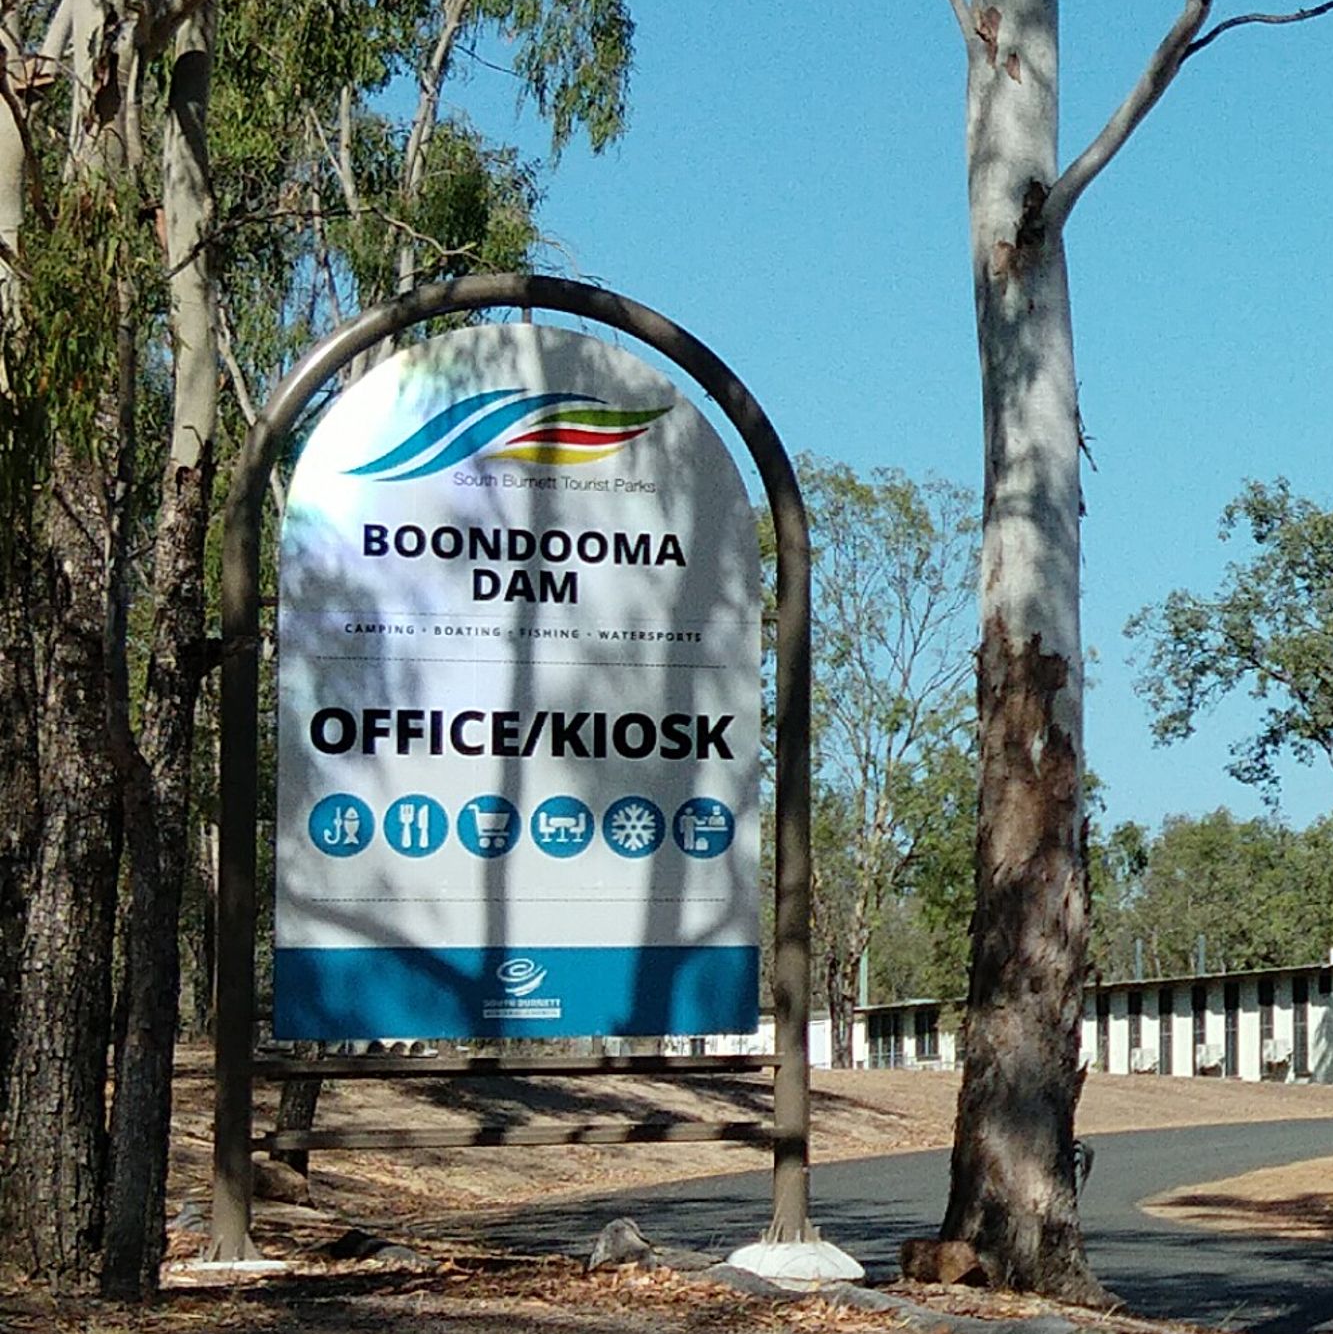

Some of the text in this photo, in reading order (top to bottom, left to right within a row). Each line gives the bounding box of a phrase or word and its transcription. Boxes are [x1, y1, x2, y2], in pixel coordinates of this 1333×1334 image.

[453, 472, 656, 494] South Burnett Tourist Parks
[363, 524, 687, 567] BOONDOOMA
[472, 568, 579, 604] DAM
[345, 623, 702, 643] CAMPING BOATING FISHING WATERSPORTS
[309, 706, 736, 760] OFFICE/KIOSK
